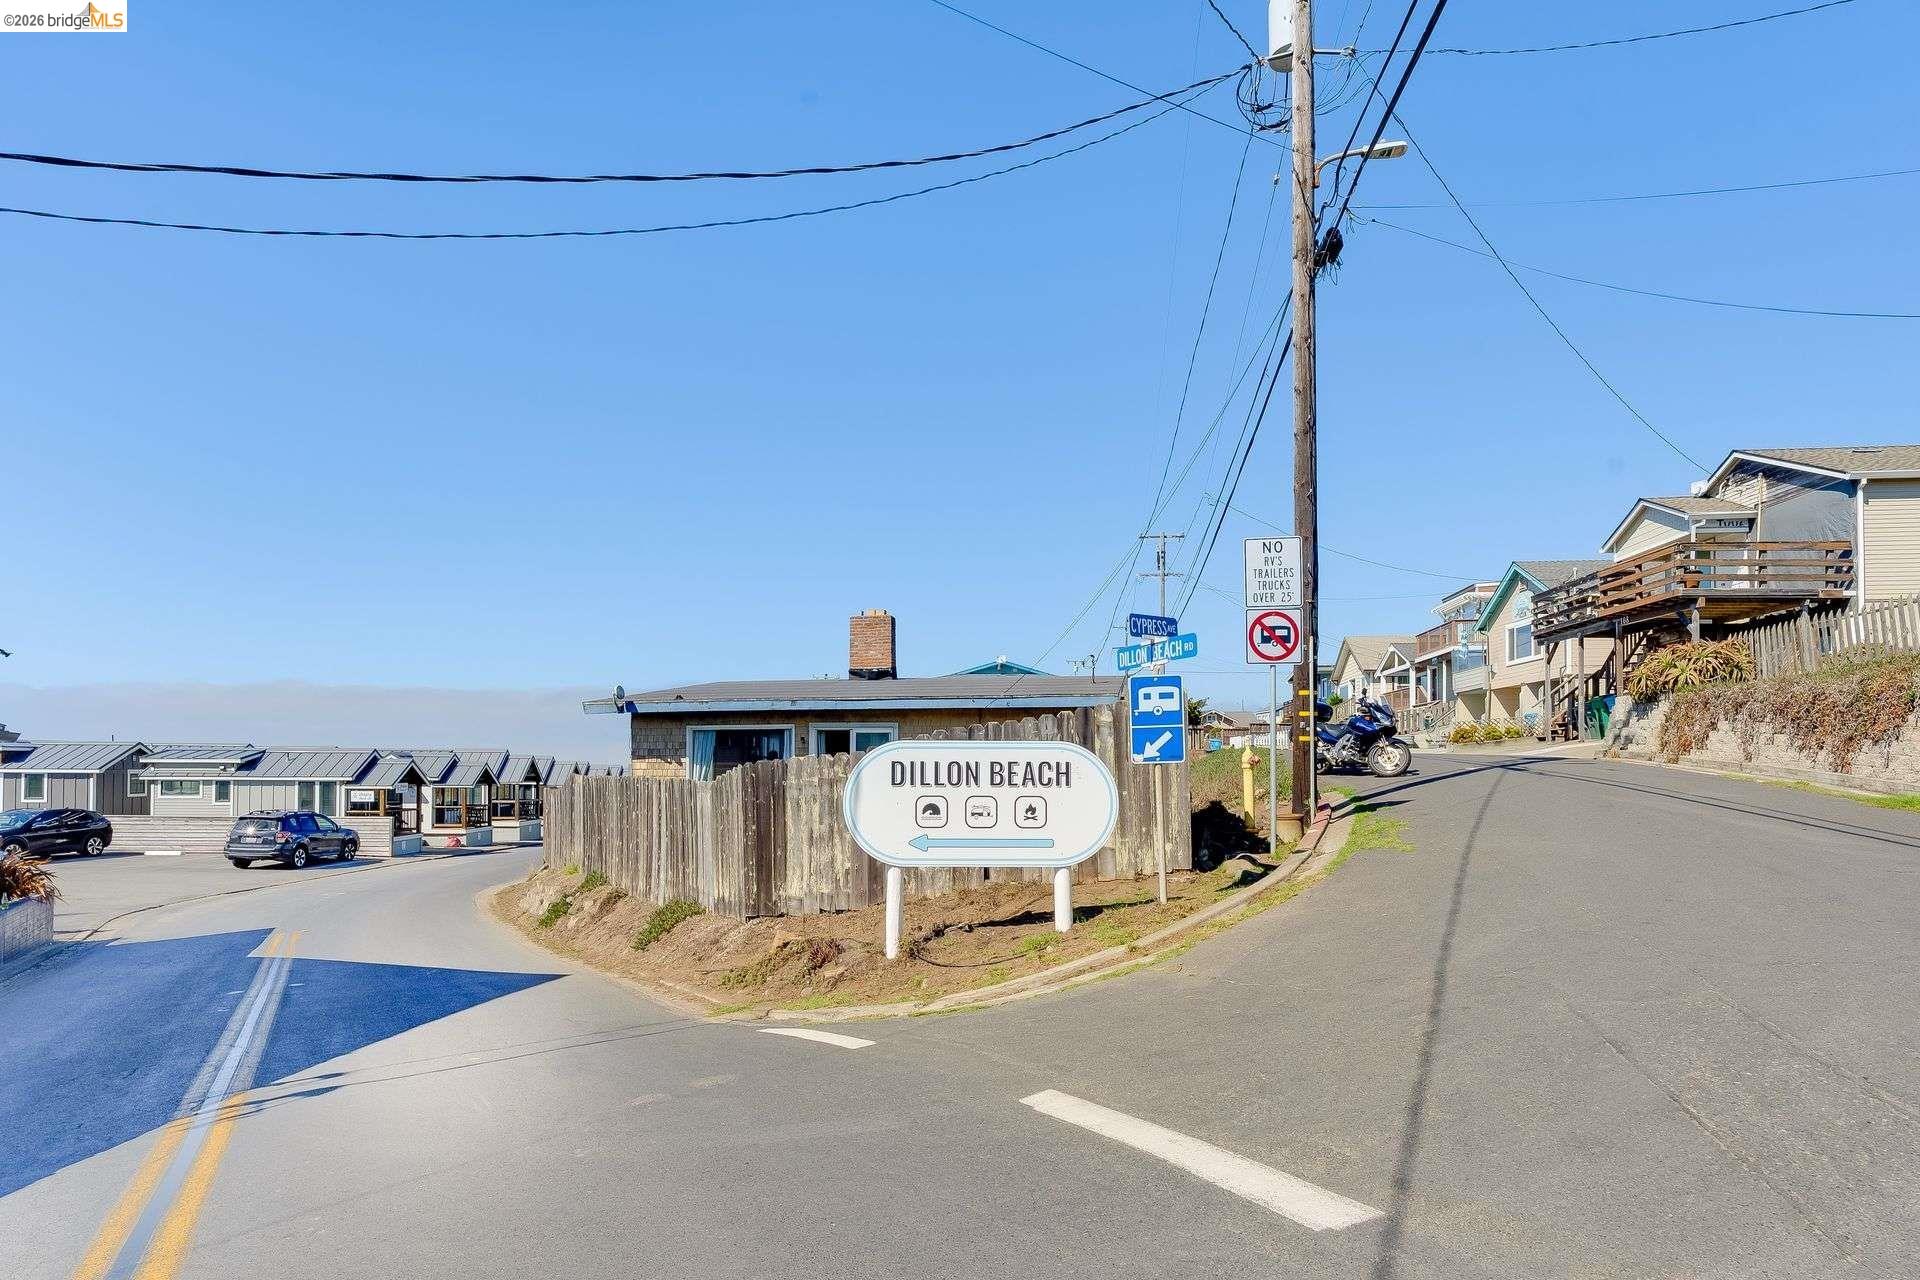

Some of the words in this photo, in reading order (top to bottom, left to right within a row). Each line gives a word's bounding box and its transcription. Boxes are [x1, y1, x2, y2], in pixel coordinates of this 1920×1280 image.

[1262, 541, 1283, 553] NO
[1264, 556, 1283, 567] RV'S
[1253, 568, 1294, 579] TRAILERS
[1258, 580, 1291, 590] TRUCKS
[1253, 592, 1275, 603] OVER
[1130, 617, 1168, 636] CYPRESS
[1167, 624, 1177, 634] AVE
[1118, 645, 1148, 667] DILLON
[1152, 639, 1183, 660] BEACH
[1183, 644, 1194, 652] RD
[890, 760, 981, 788] DILLON
[989, 760, 1072, 788] BEACH
